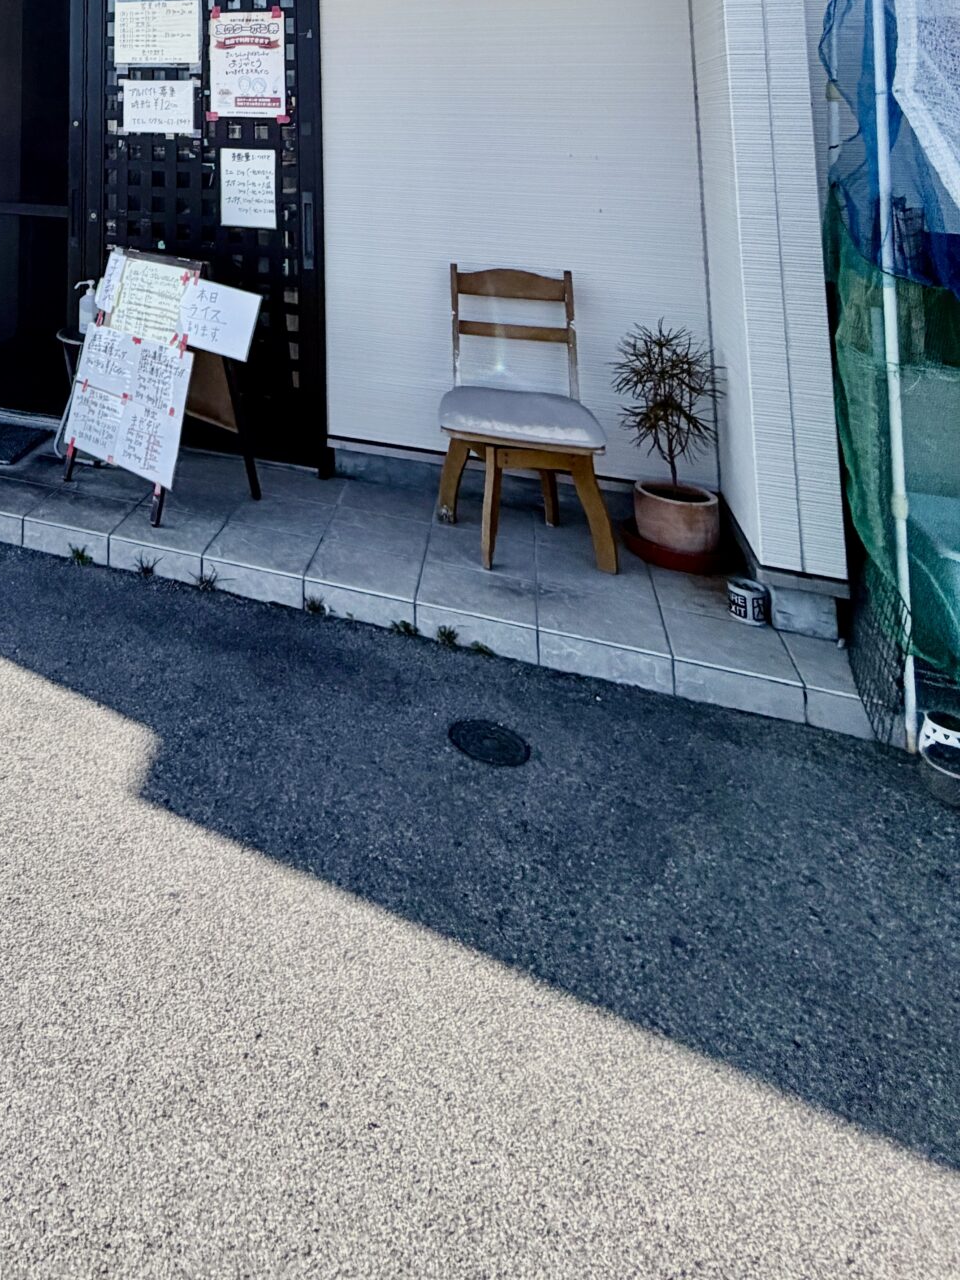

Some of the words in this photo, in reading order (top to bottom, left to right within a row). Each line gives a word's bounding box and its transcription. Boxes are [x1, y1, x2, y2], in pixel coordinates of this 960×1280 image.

[196, 288, 219, 303] 本日
[190, 304, 222, 322] ライス
